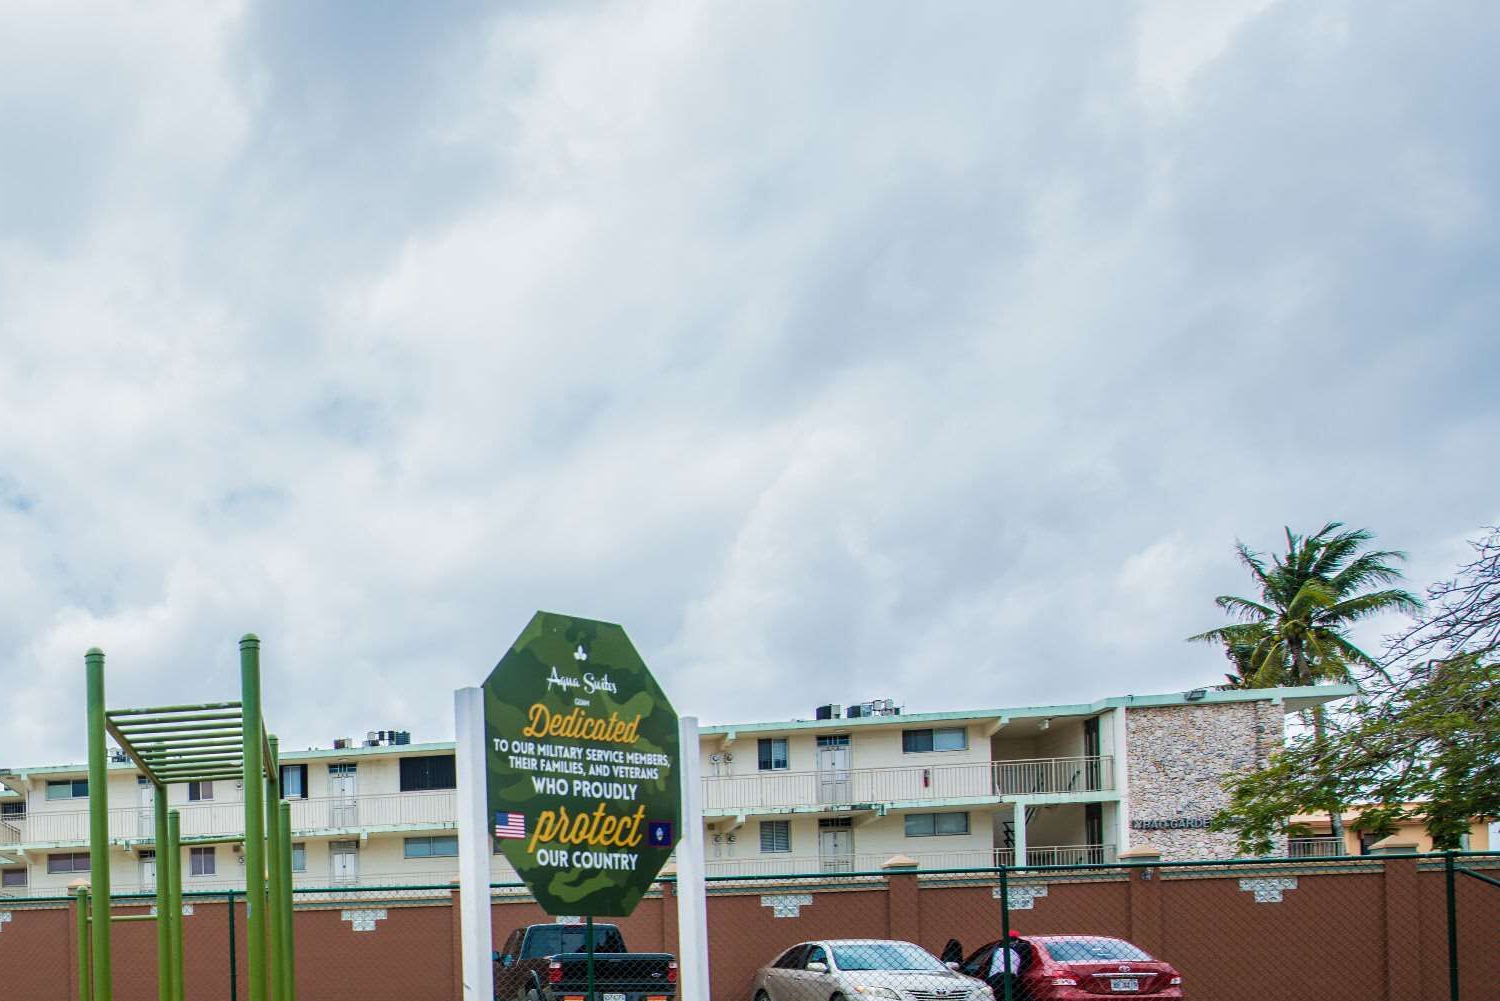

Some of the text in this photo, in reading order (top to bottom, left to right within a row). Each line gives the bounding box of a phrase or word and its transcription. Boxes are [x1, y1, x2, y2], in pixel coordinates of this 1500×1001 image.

[546, 666, 617, 694] Aqua Suites
[523, 703, 642, 744] Dedicated
[493, 738, 671, 768] TO OUR MILITARY SERVICE MEMBERS,
[508, 755, 659, 780] THEIR FAMILIES, AND VETERANS
[531, 775, 638, 801] WHO PROUDLY
[527, 802, 646, 854] protect
[536, 849, 638, 871] OUR COUNTRY
